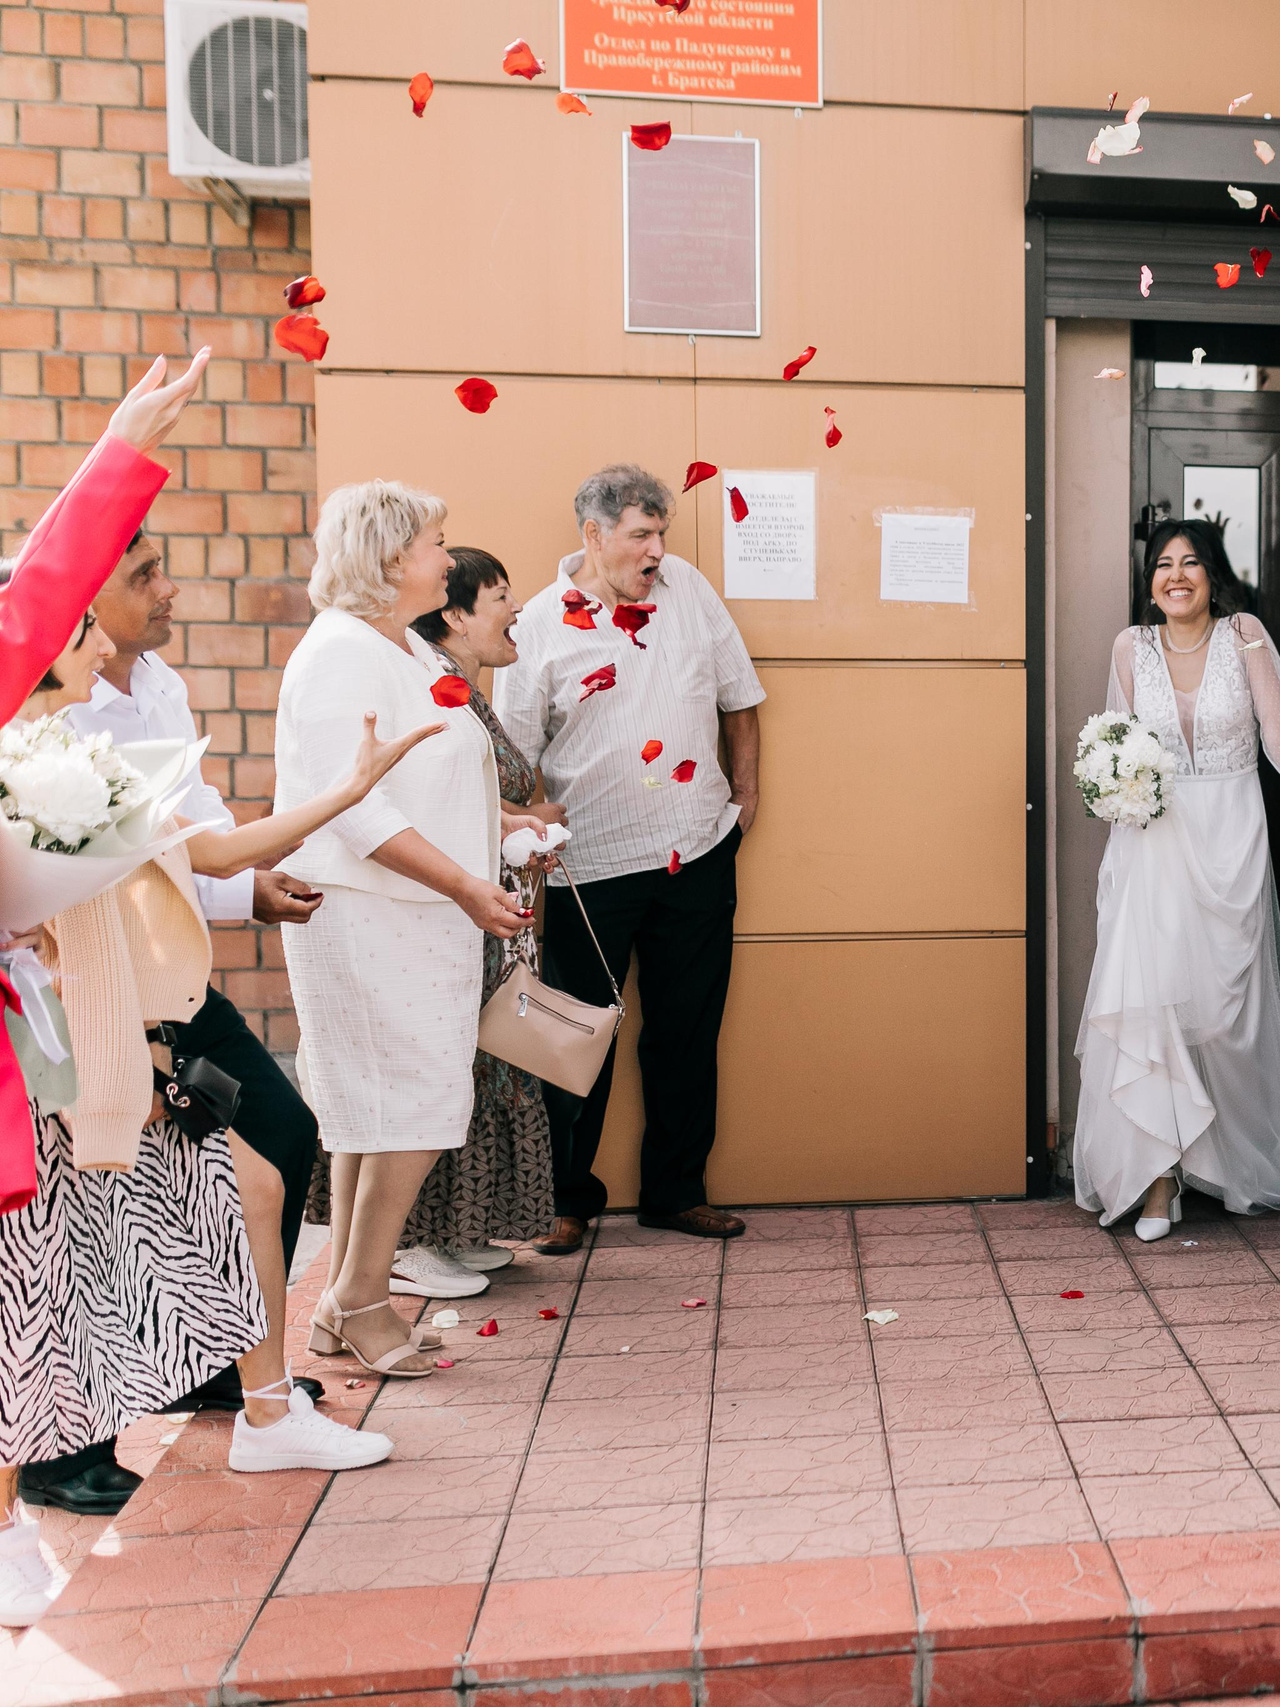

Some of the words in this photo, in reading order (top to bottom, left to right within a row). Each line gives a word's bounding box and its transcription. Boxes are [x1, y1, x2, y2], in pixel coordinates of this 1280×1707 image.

[613, 5, 704, 27] Иркутской
[709, 12, 774, 30] области
[594, 32, 645, 51] Отдел
[651, 39, 671, 52] по
[676, 37, 774, 62] Падунскому
[781, 47, 791, 60] и
[584, 49, 725, 75] Правобережному
[731, 59, 802, 77] районам
[652, 74, 664, 87] г.
[668, 71, 735, 92] Братска
